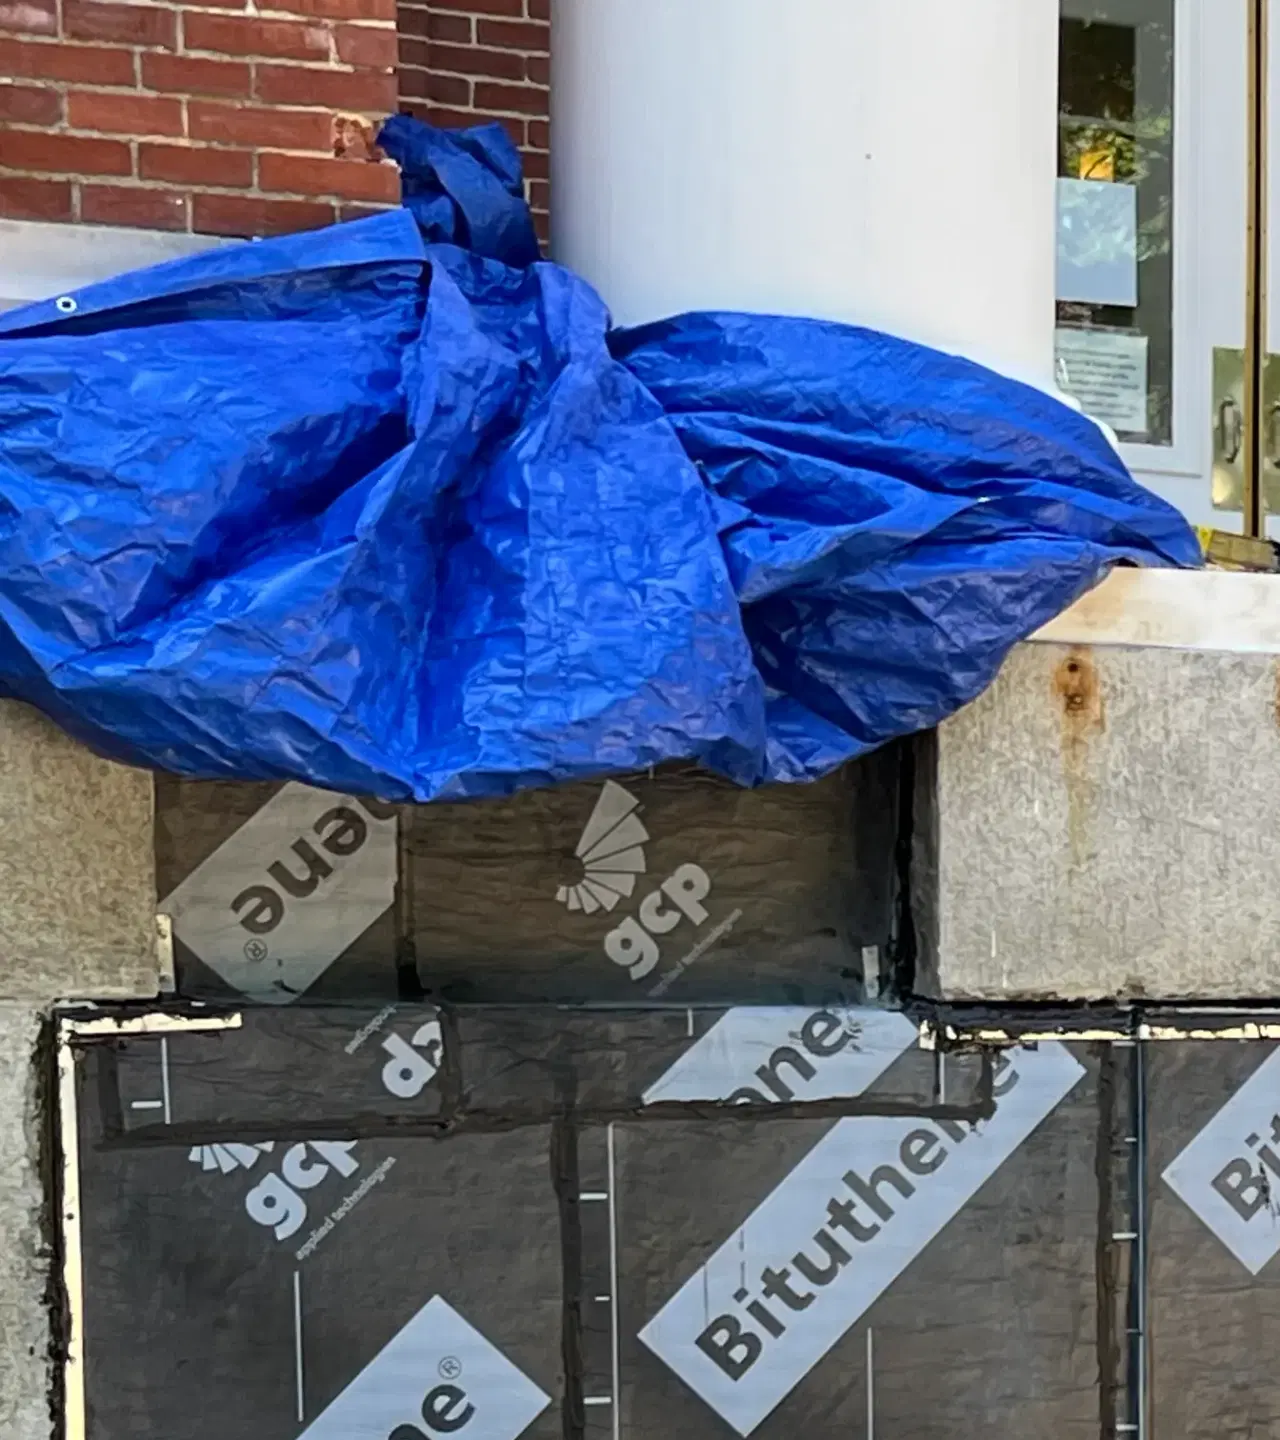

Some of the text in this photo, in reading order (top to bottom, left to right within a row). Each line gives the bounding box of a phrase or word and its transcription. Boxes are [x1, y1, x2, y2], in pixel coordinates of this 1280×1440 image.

[604, 863, 711, 979] gcp
[294, 1155, 396, 1261] applied technologies
[695, 1044, 1021, 1382] Bituthe
